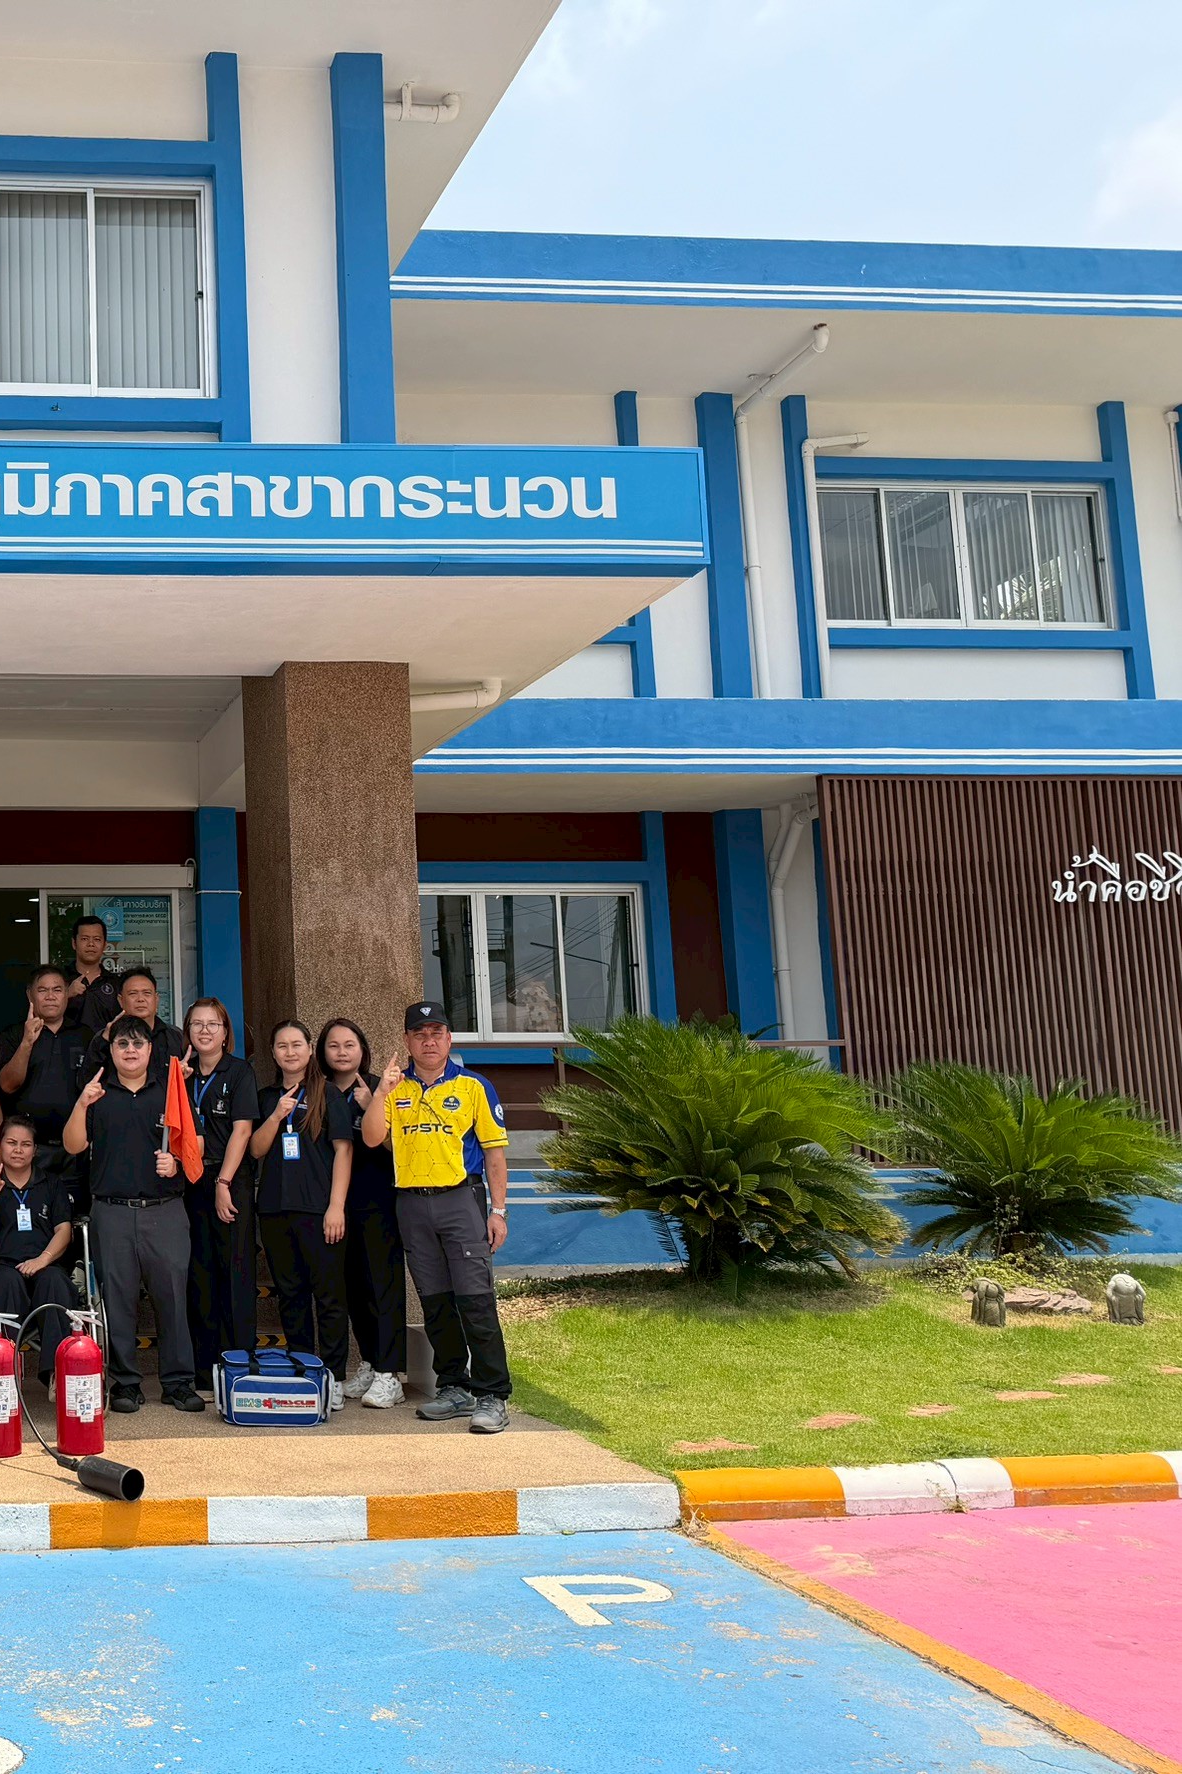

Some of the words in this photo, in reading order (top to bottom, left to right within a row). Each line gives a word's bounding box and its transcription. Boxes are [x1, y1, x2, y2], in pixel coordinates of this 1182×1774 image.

[113, 898, 169, 909] เส้นทางรับบริกา
[401, 1122, 454, 1137] TPSTC
[235, 1397, 262, 1409] EMS
[521, 1574, 674, 1627] P
